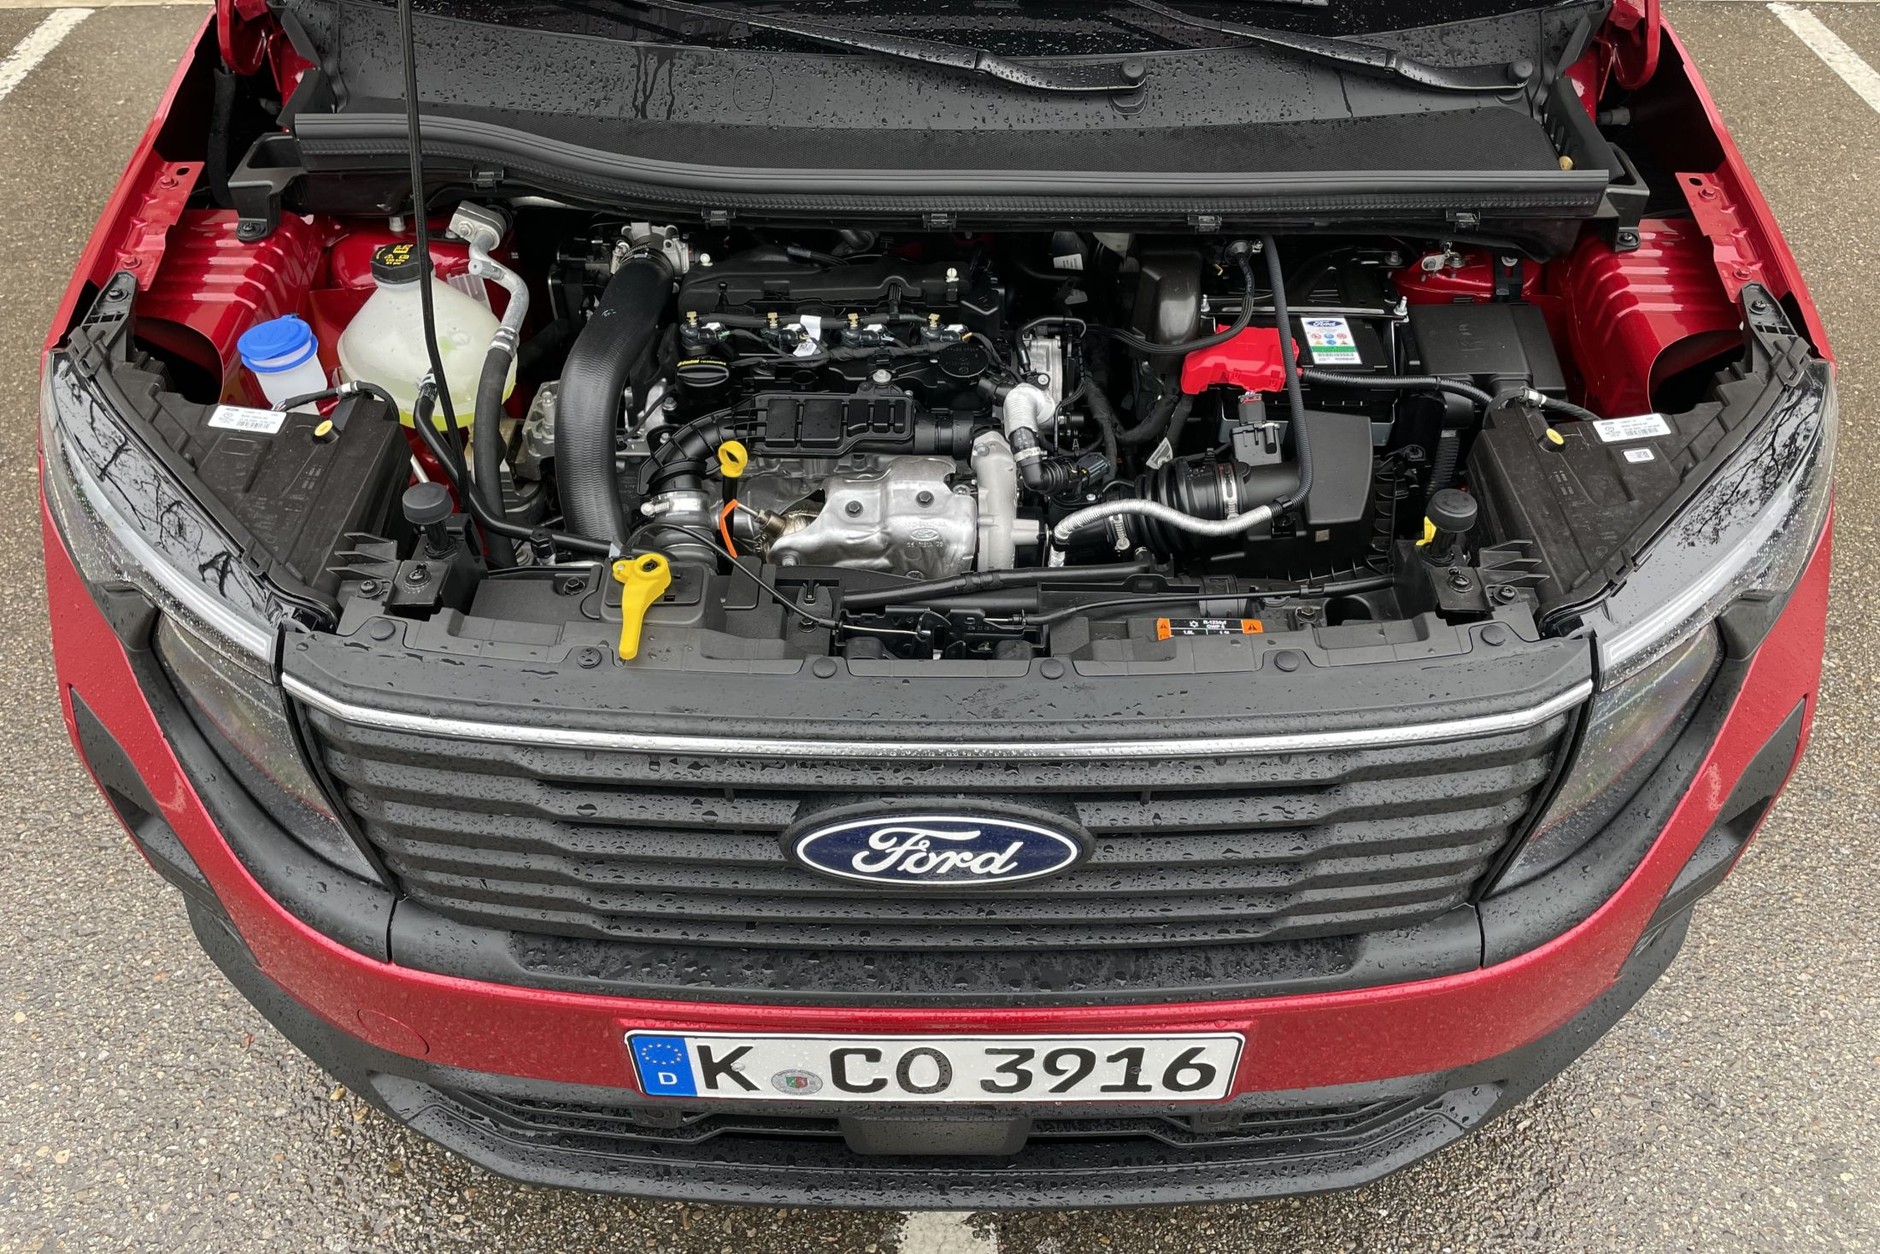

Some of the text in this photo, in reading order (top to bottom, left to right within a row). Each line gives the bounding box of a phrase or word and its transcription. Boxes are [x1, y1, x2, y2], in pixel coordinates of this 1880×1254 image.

[852, 827, 1023, 874] Ford
[658, 1071, 678, 1086] D
[696, 1045, 760, 1091] K
[830, 1047, 953, 1094] CO
[980, 1047, 1217, 1094] 3916
